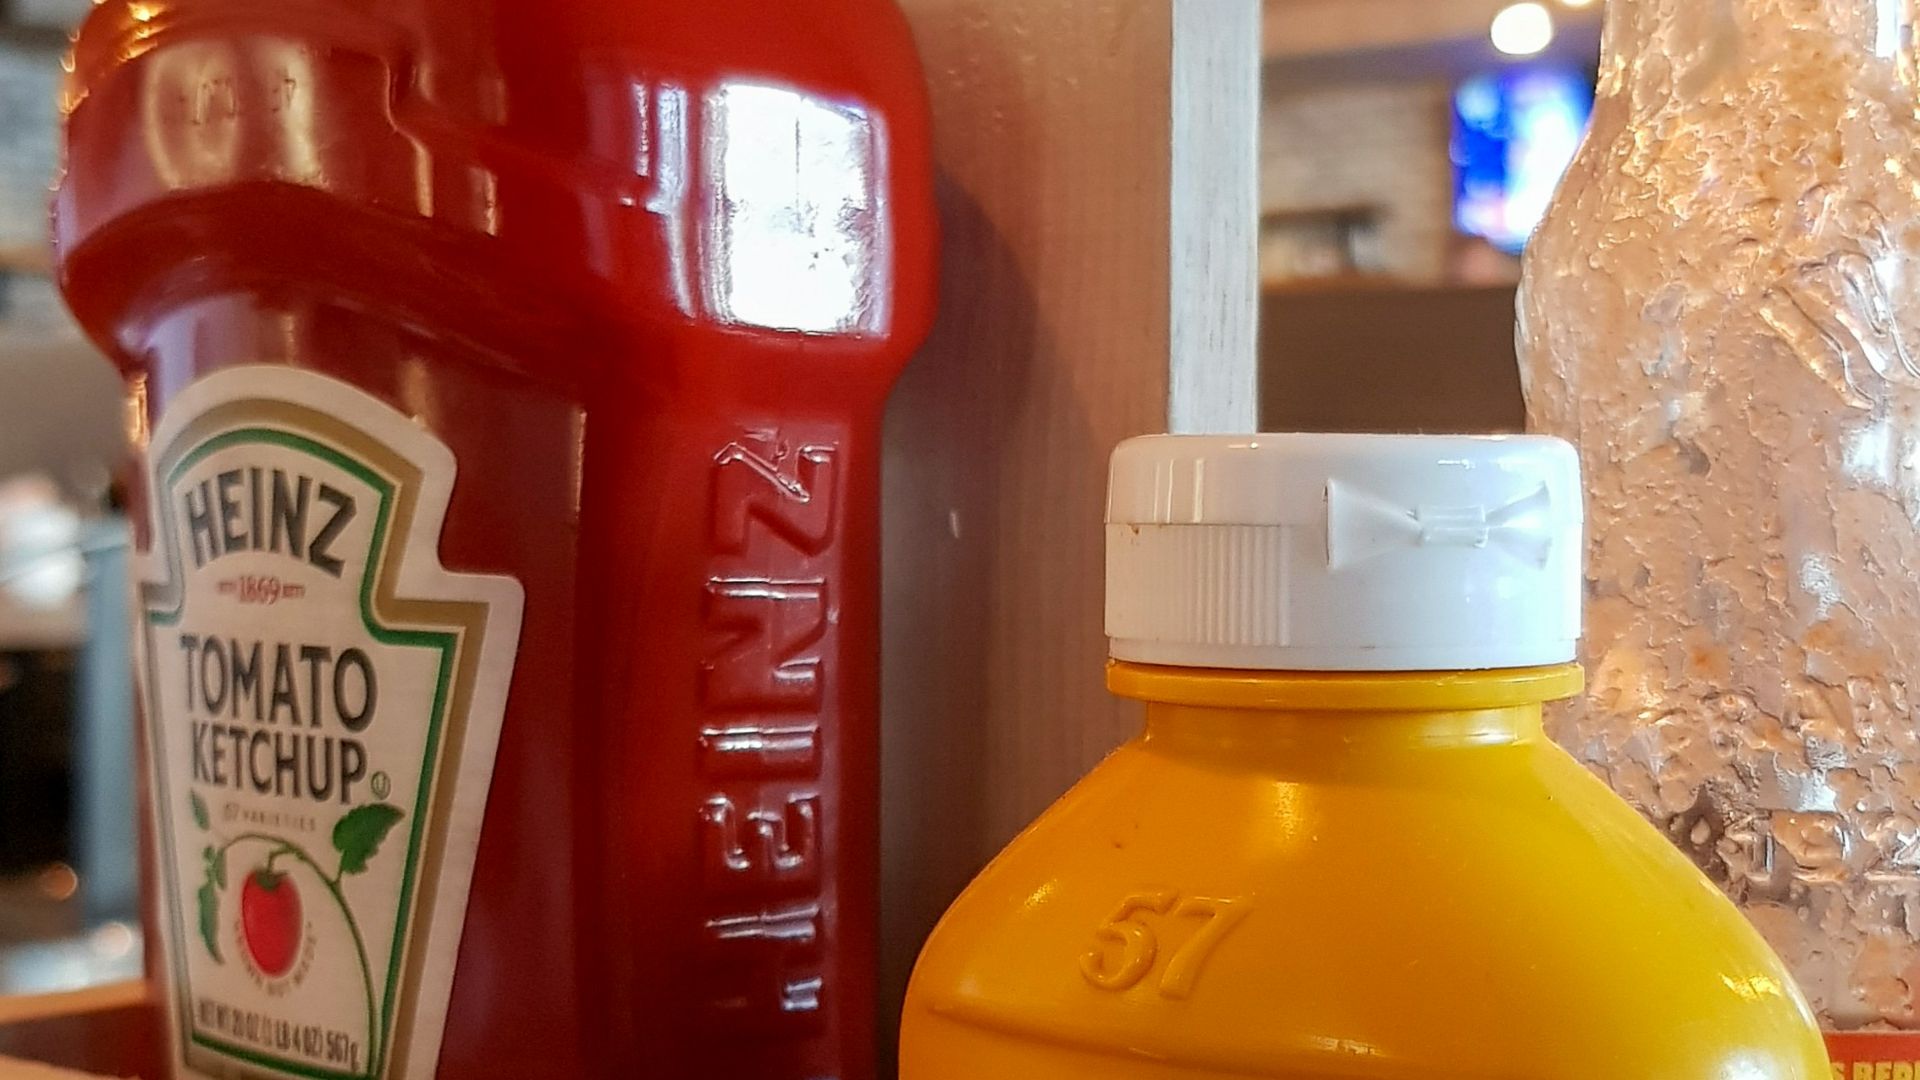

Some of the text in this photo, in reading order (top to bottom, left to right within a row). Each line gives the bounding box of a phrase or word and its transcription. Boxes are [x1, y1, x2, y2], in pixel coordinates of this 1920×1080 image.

[186, 467, 357, 579] HEINZ
[239, 575, 281, 605] 1869
[180, 632, 378, 733] TOMATO
[700, 436, 842, 1028] HEINZ
[192, 719, 367, 804] KETCHUP
[1081, 888, 1250, 1001] 57
